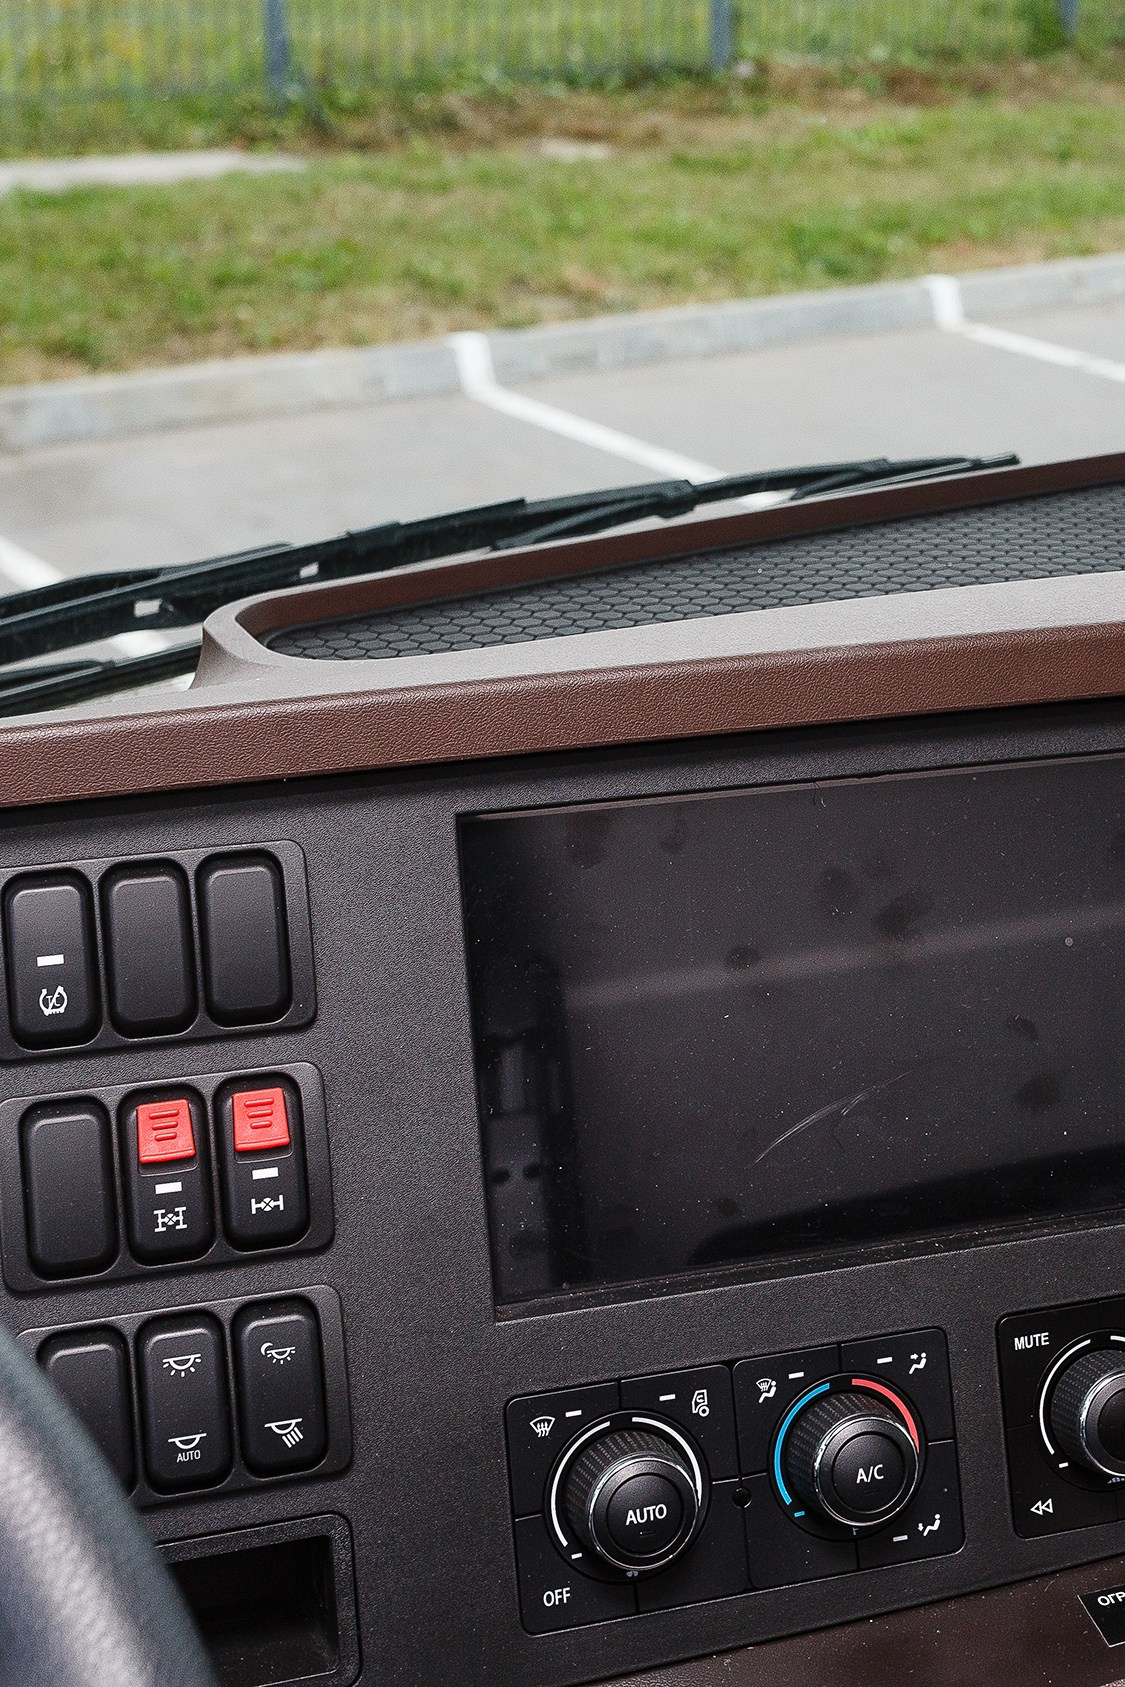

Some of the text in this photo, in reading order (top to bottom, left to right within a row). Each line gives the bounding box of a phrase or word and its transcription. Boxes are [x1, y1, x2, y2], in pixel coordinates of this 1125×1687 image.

[1014, 1332, 1050, 1351] MUTE
[176, 1450, 201, 1463] AUTO
[855, 1463, 885, 1485] A/C
[625, 1504, 667, 1526] AUTO
[543, 1587, 571, 1607] OFF
